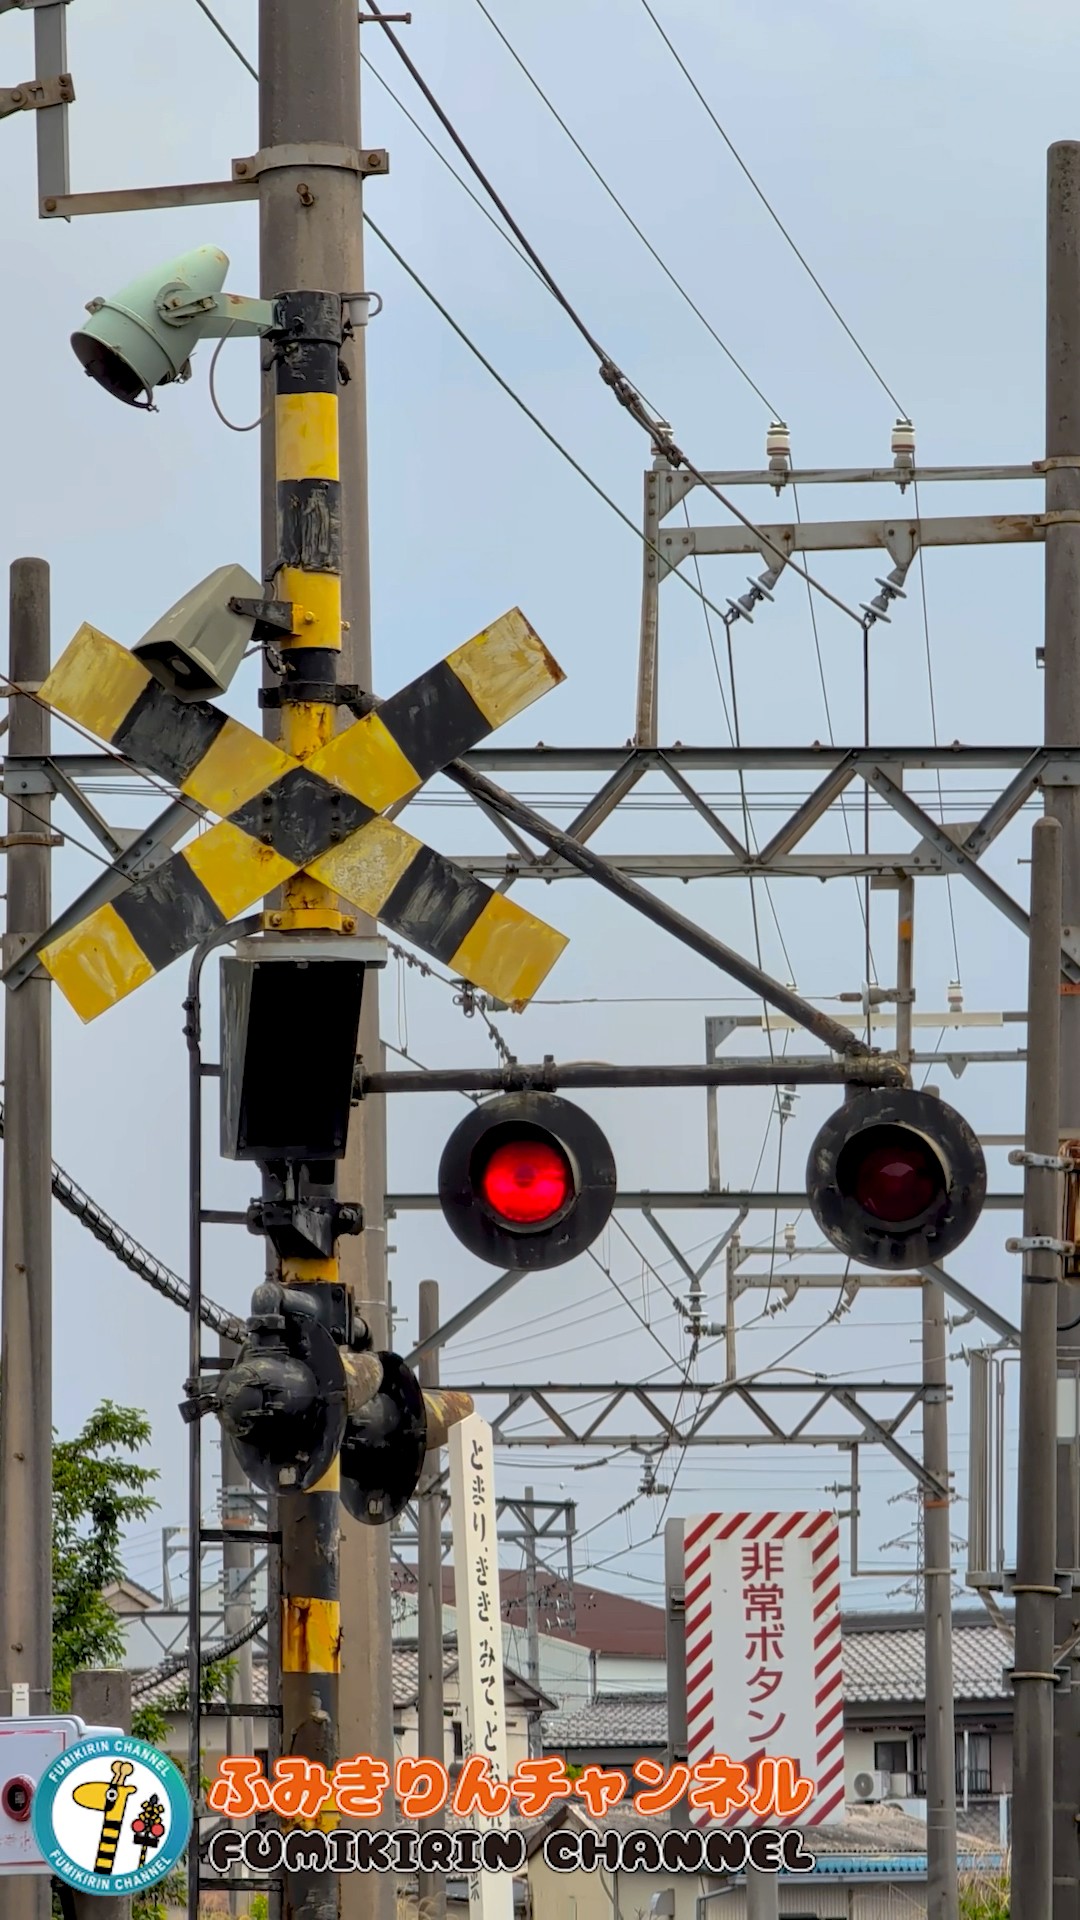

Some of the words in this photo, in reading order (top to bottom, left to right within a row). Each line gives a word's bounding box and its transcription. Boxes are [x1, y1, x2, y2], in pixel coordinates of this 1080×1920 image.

[741, 1541, 786, 1743] 非常ボタン
